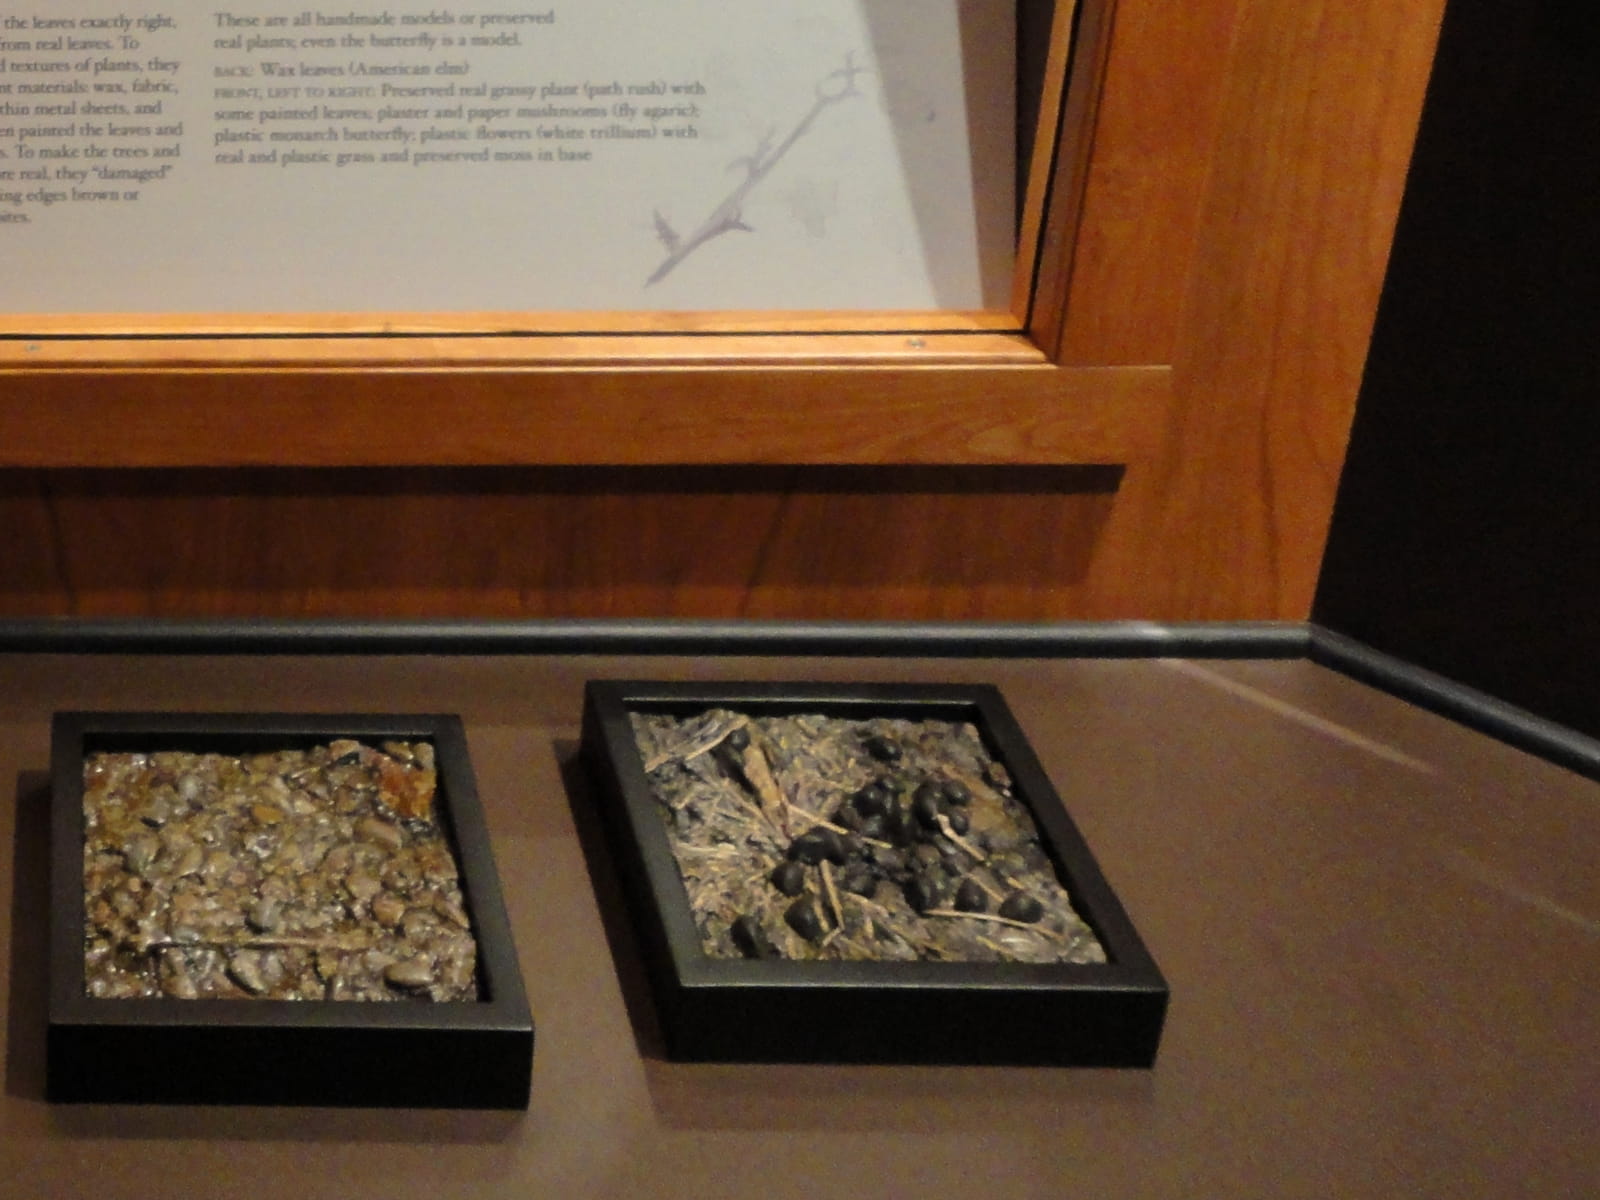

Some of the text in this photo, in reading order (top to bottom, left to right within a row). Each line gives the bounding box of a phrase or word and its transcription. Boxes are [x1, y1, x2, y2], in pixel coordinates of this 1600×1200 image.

[3, 15, 27, 30] the
[32, 14, 75, 30] leaves
[79, 14, 131, 33] exactly
[35, 36, 63, 51] real
[120, 35, 139, 50] To
